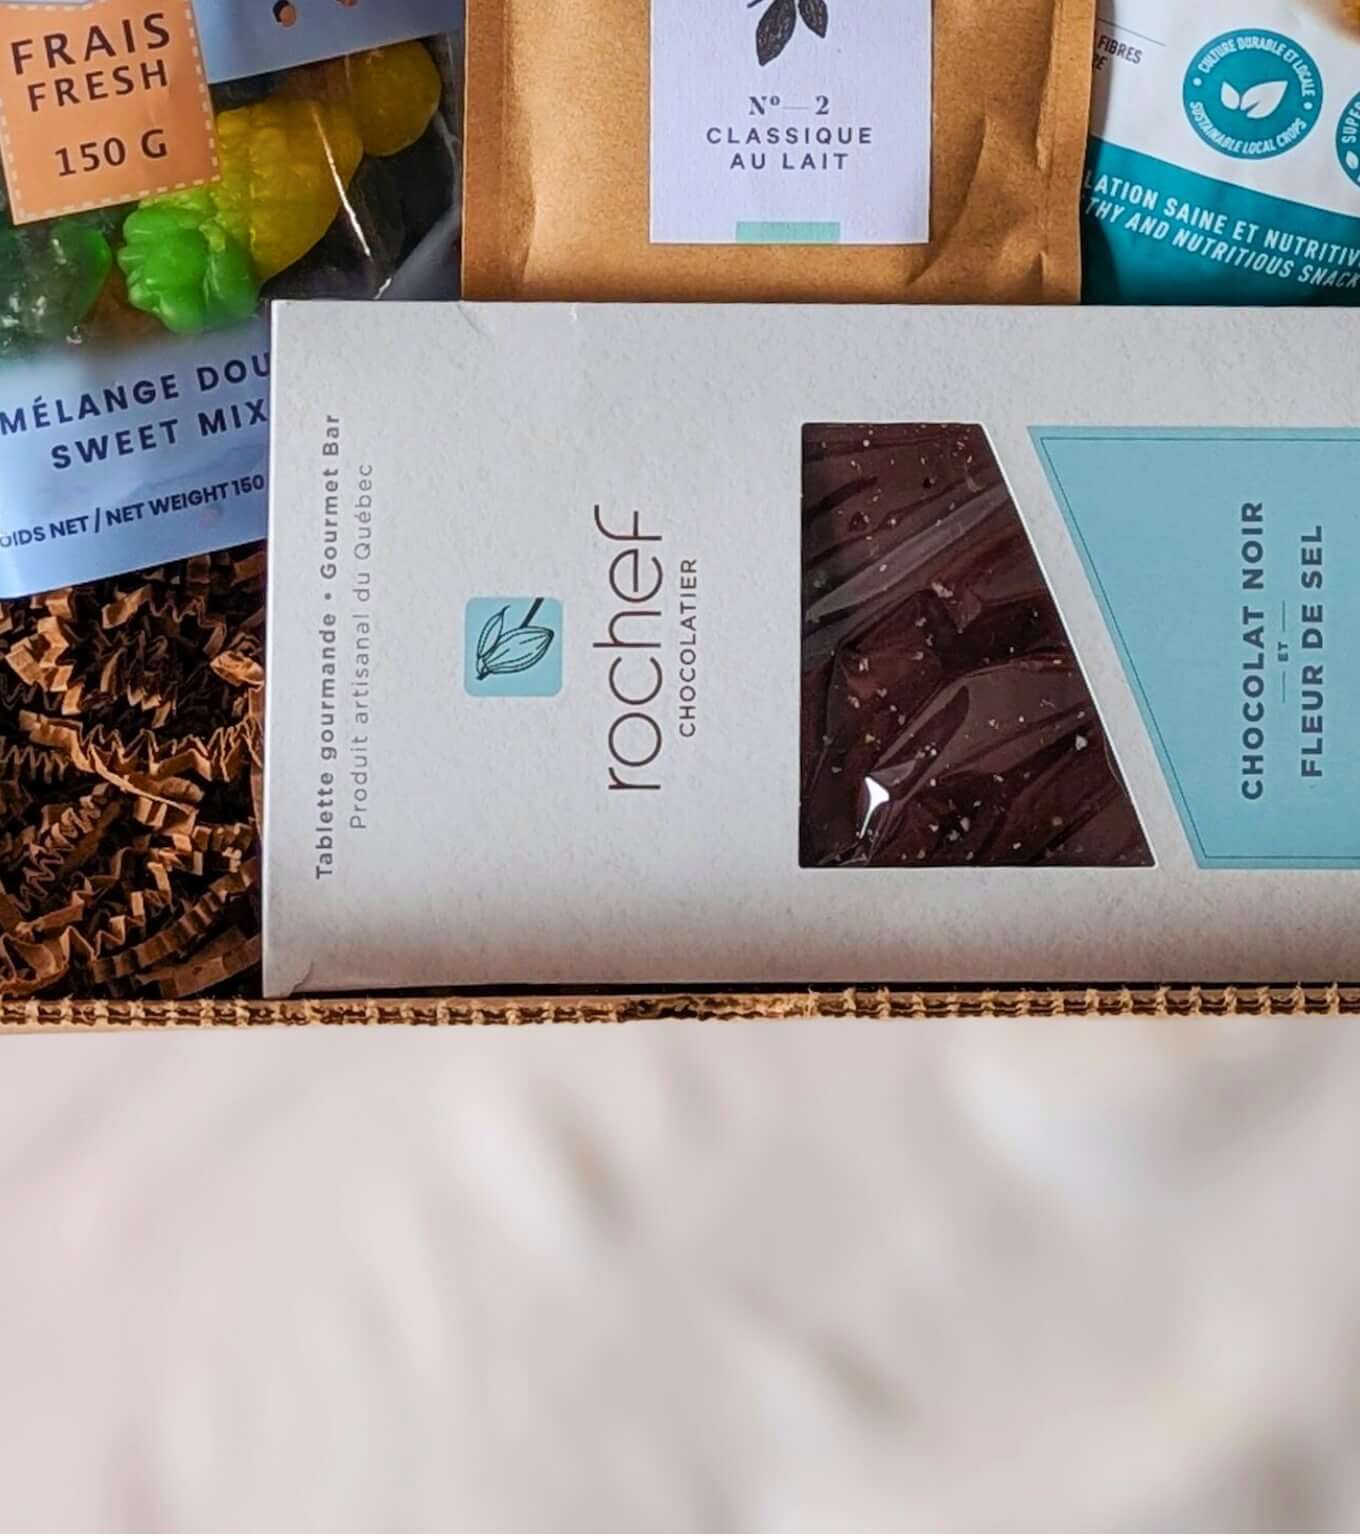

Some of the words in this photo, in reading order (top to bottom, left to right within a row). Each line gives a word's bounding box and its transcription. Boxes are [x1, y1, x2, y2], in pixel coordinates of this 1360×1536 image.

[11, 13, 170, 75] FRAIS
[1098, 35, 1143, 64] FIBRES
[1198, 39, 1237, 73] CULTURE
[1237, 36, 1287, 56] DURABLE
[1282, 48, 1300, 63] ET
[1292, 59, 1316, 96] LOCALE
[27, 59, 168, 112] FRESH
[815, 95, 831, 116] 2
[55, 137, 127, 177] 150
[141, 128, 168, 159] G
[706, 126, 874, 145] CLASSIQUE
[1190, 101, 1243, 153] SUSTAINABLE
[1242, 140, 1277, 154] LOCAL
[1276, 117, 1307, 147] CROPS
[730, 153, 767, 170] AU
[782, 152, 850, 170] LAIT
[1084, 169, 1159, 210] LATION
[1163, 197, 1228, 234] SAINE
[1232, 221, 1259, 244] ET
[1124, 212, 1170, 240] AND
[1172, 228, 1295, 279] NUTRITIOUS
[196, 352, 271, 391] DOU
[51, 419, 180, 470] SWEET
[198, 398, 269, 437] MIX
[322, 415, 340, 456] Bar
[50, 515, 90, 539] NET
[106, 503, 145, 527] NET
[148, 482, 230, 516] WEIGHT
[232, 474, 265, 496] 150
[320, 467, 339, 580] Gourmet
[354, 464, 373, 560] Québec
[1241, 501, 1265, 590] NOIR
[1301, 525, 1323, 589] SEL
[352, 572, 371, 603] du
[593, 504, 663, 790] rochef
[679, 558, 697, 738] CHOCOLATIER
[1277, 641, 1289, 662] ET
[1301, 603, 1324, 649] DE
[319, 613, 337, 761] gourmande
[352, 613, 371, 724] artisanal
[1241, 605, 1265, 800] CHOCOLAT
[1301, 665, 1324, 777] FLEUR
[349, 735, 369, 830] Produit
[315, 771, 334, 880] Tablette
